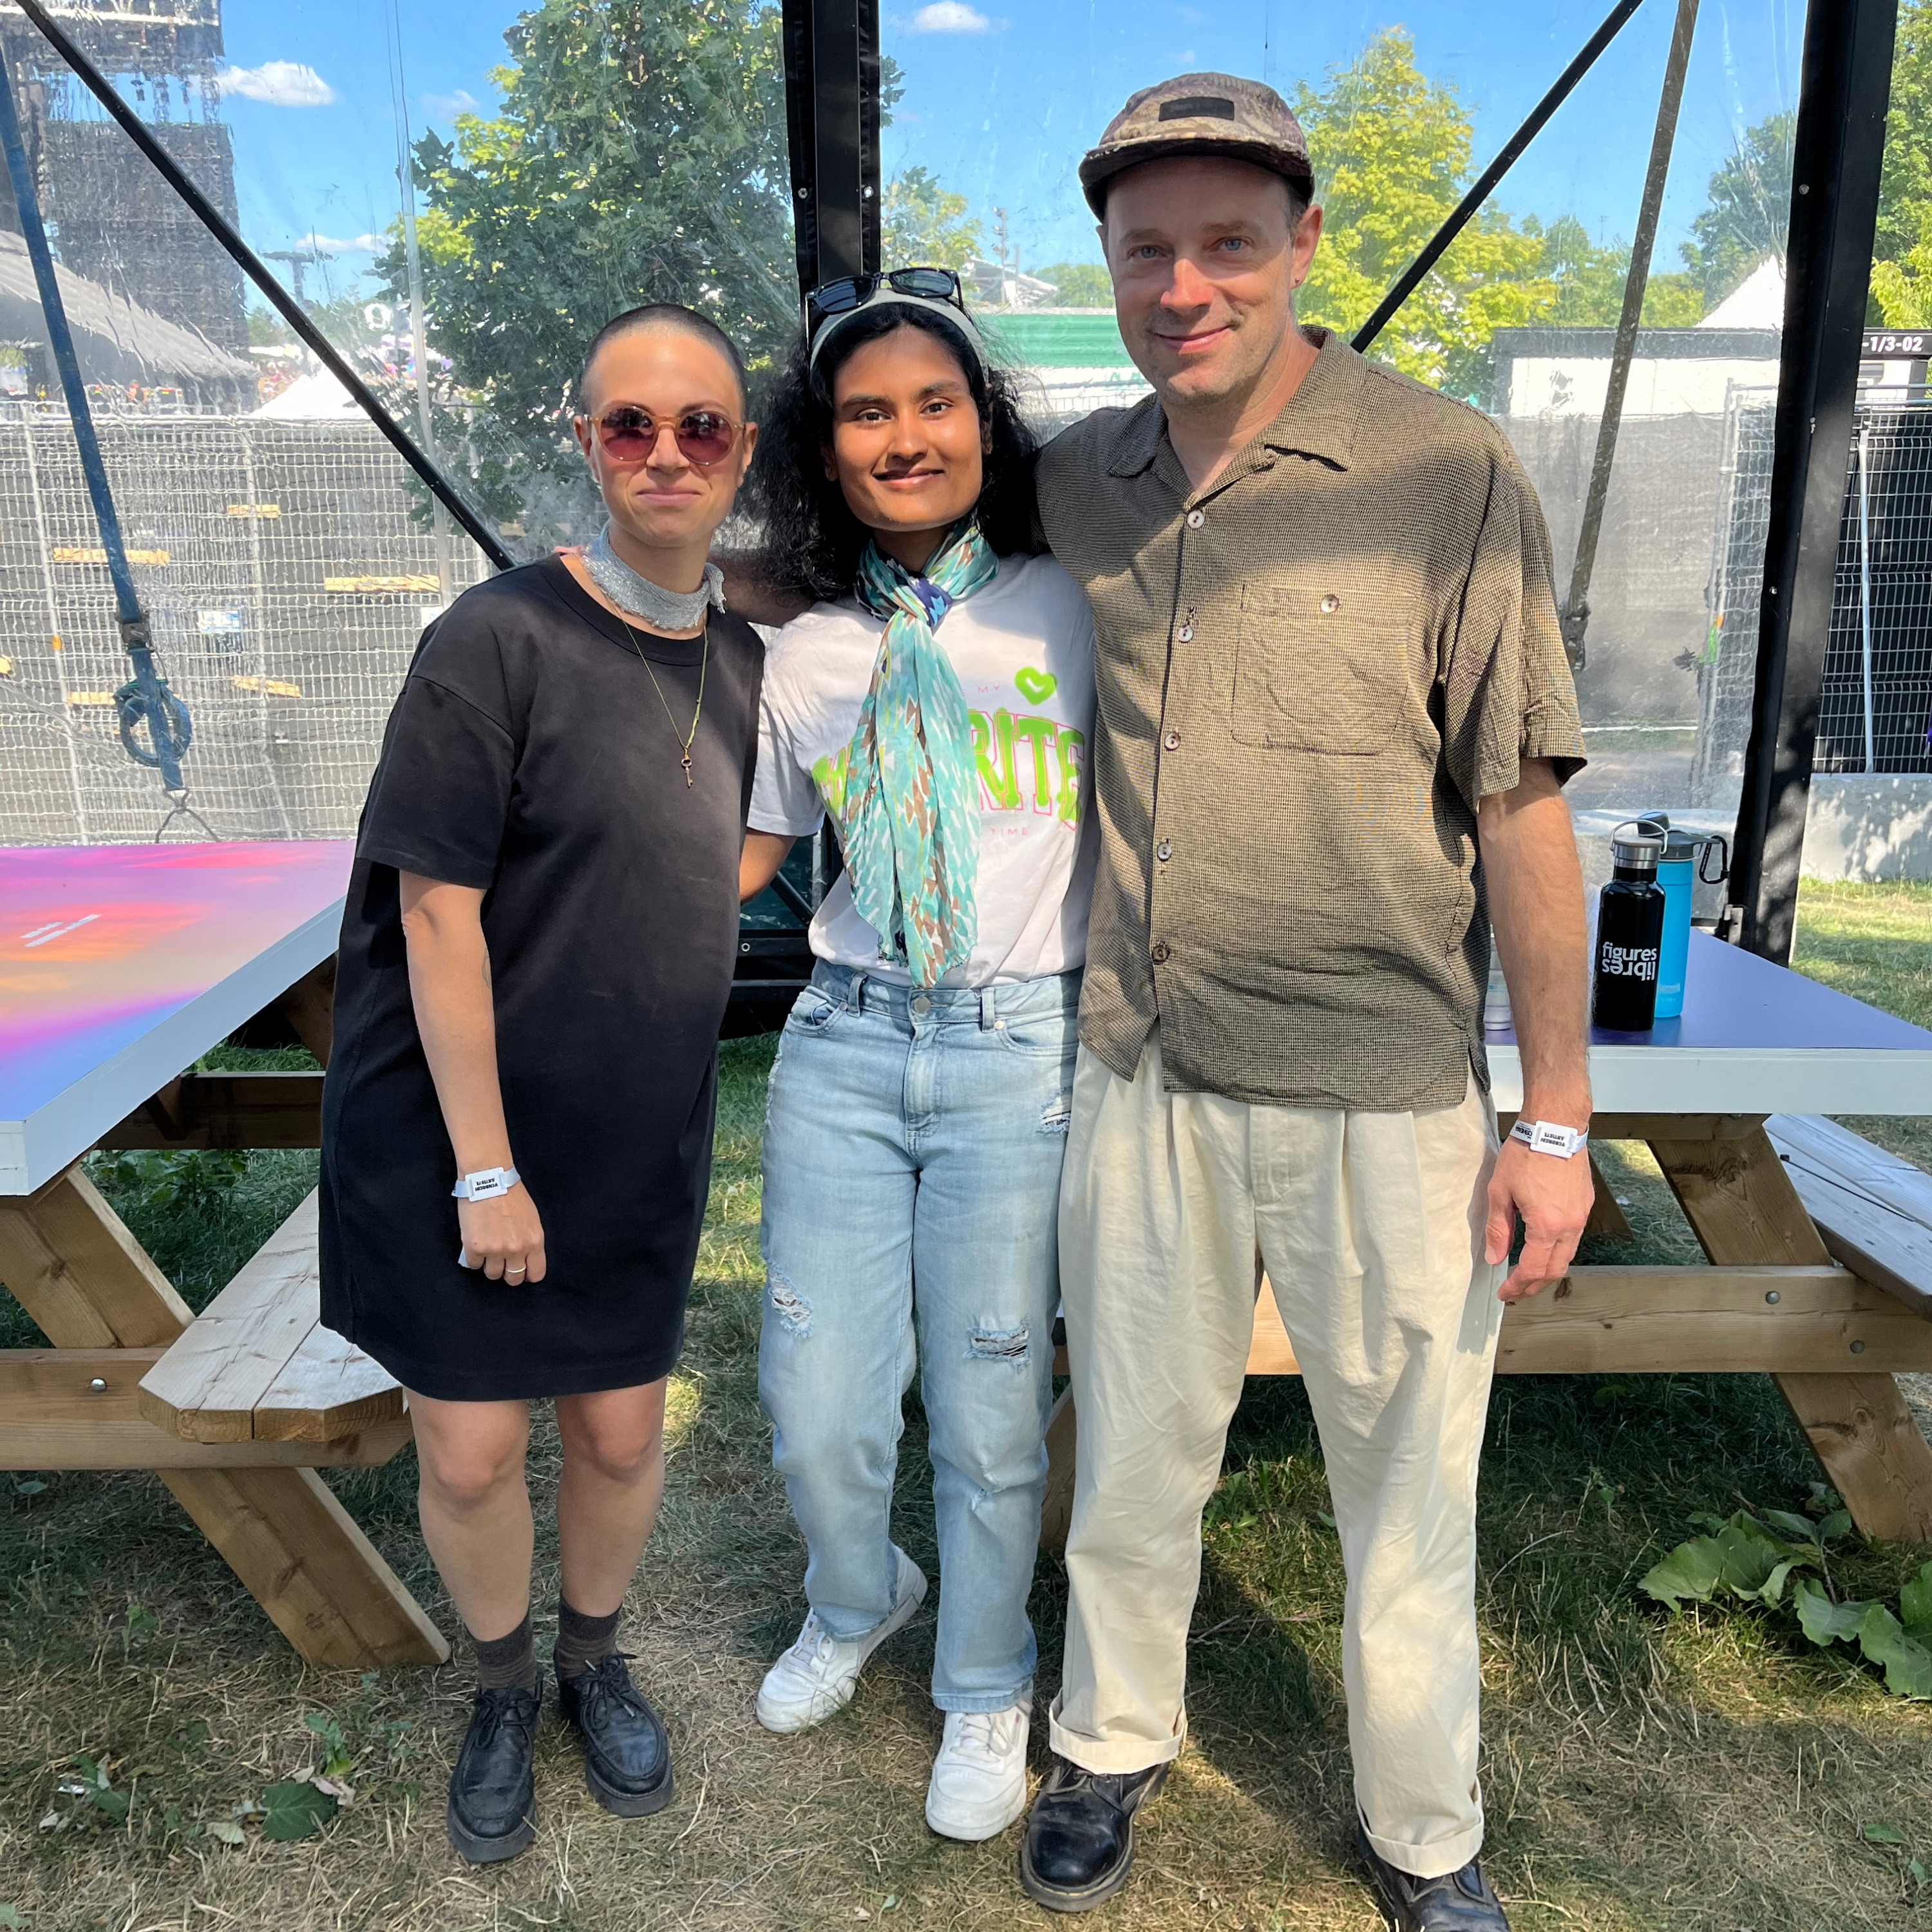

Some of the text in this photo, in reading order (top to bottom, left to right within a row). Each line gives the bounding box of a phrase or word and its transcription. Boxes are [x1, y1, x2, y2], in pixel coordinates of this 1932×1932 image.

[977, 685, 1000, 694] MY
[990, 828, 1029, 836] TIME
[1602, 942, 1657, 963] figures
[1602, 959, 1656, 981] libres
